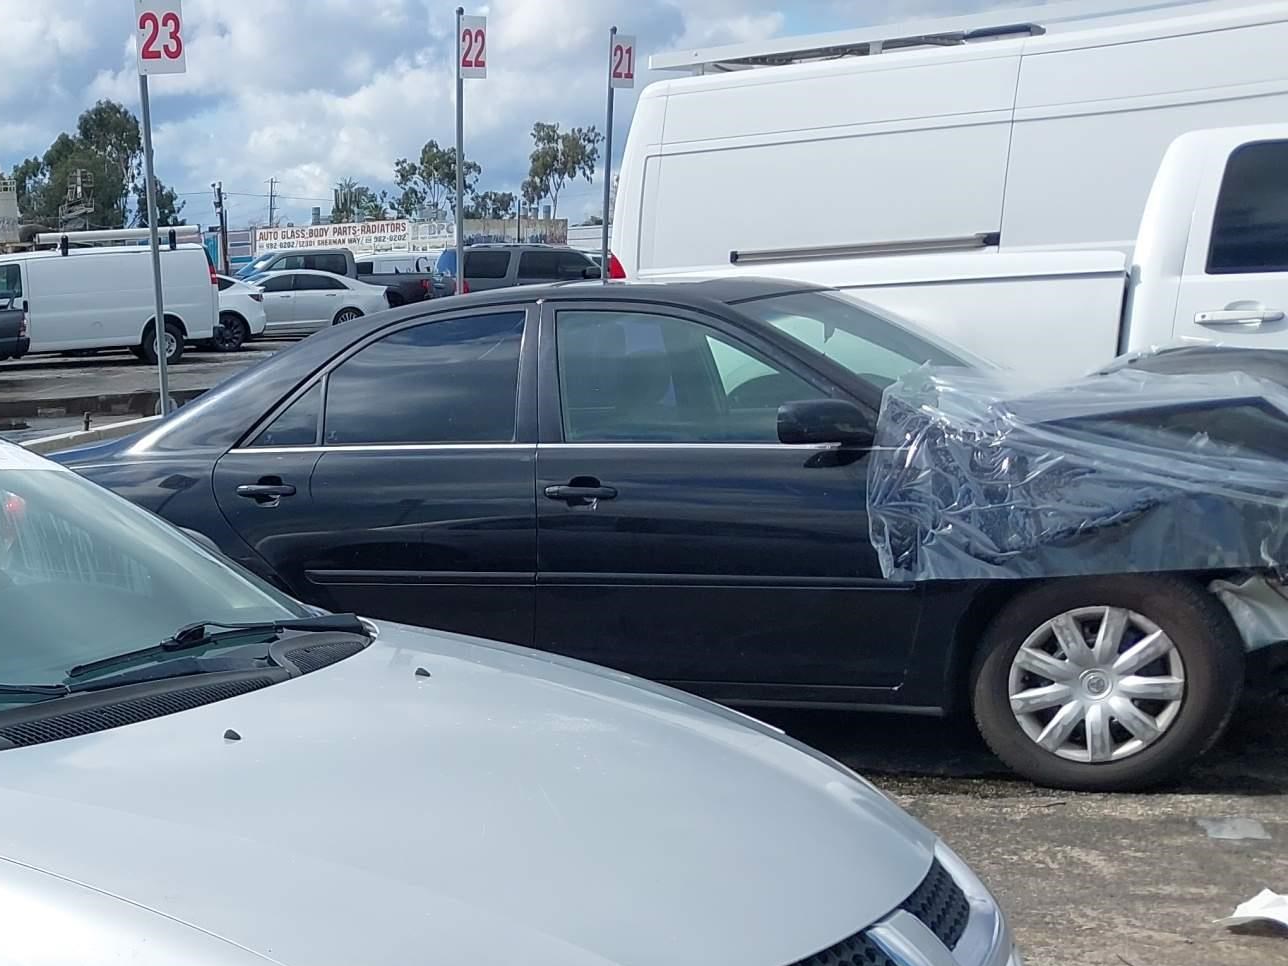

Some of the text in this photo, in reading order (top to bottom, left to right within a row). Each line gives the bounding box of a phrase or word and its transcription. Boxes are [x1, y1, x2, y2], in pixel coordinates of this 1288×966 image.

[139, 12, 182, 59] 23
[461, 28, 486, 68] 22
[612, 44, 634, 79] 21
[259, 231, 278, 241] AUTO
